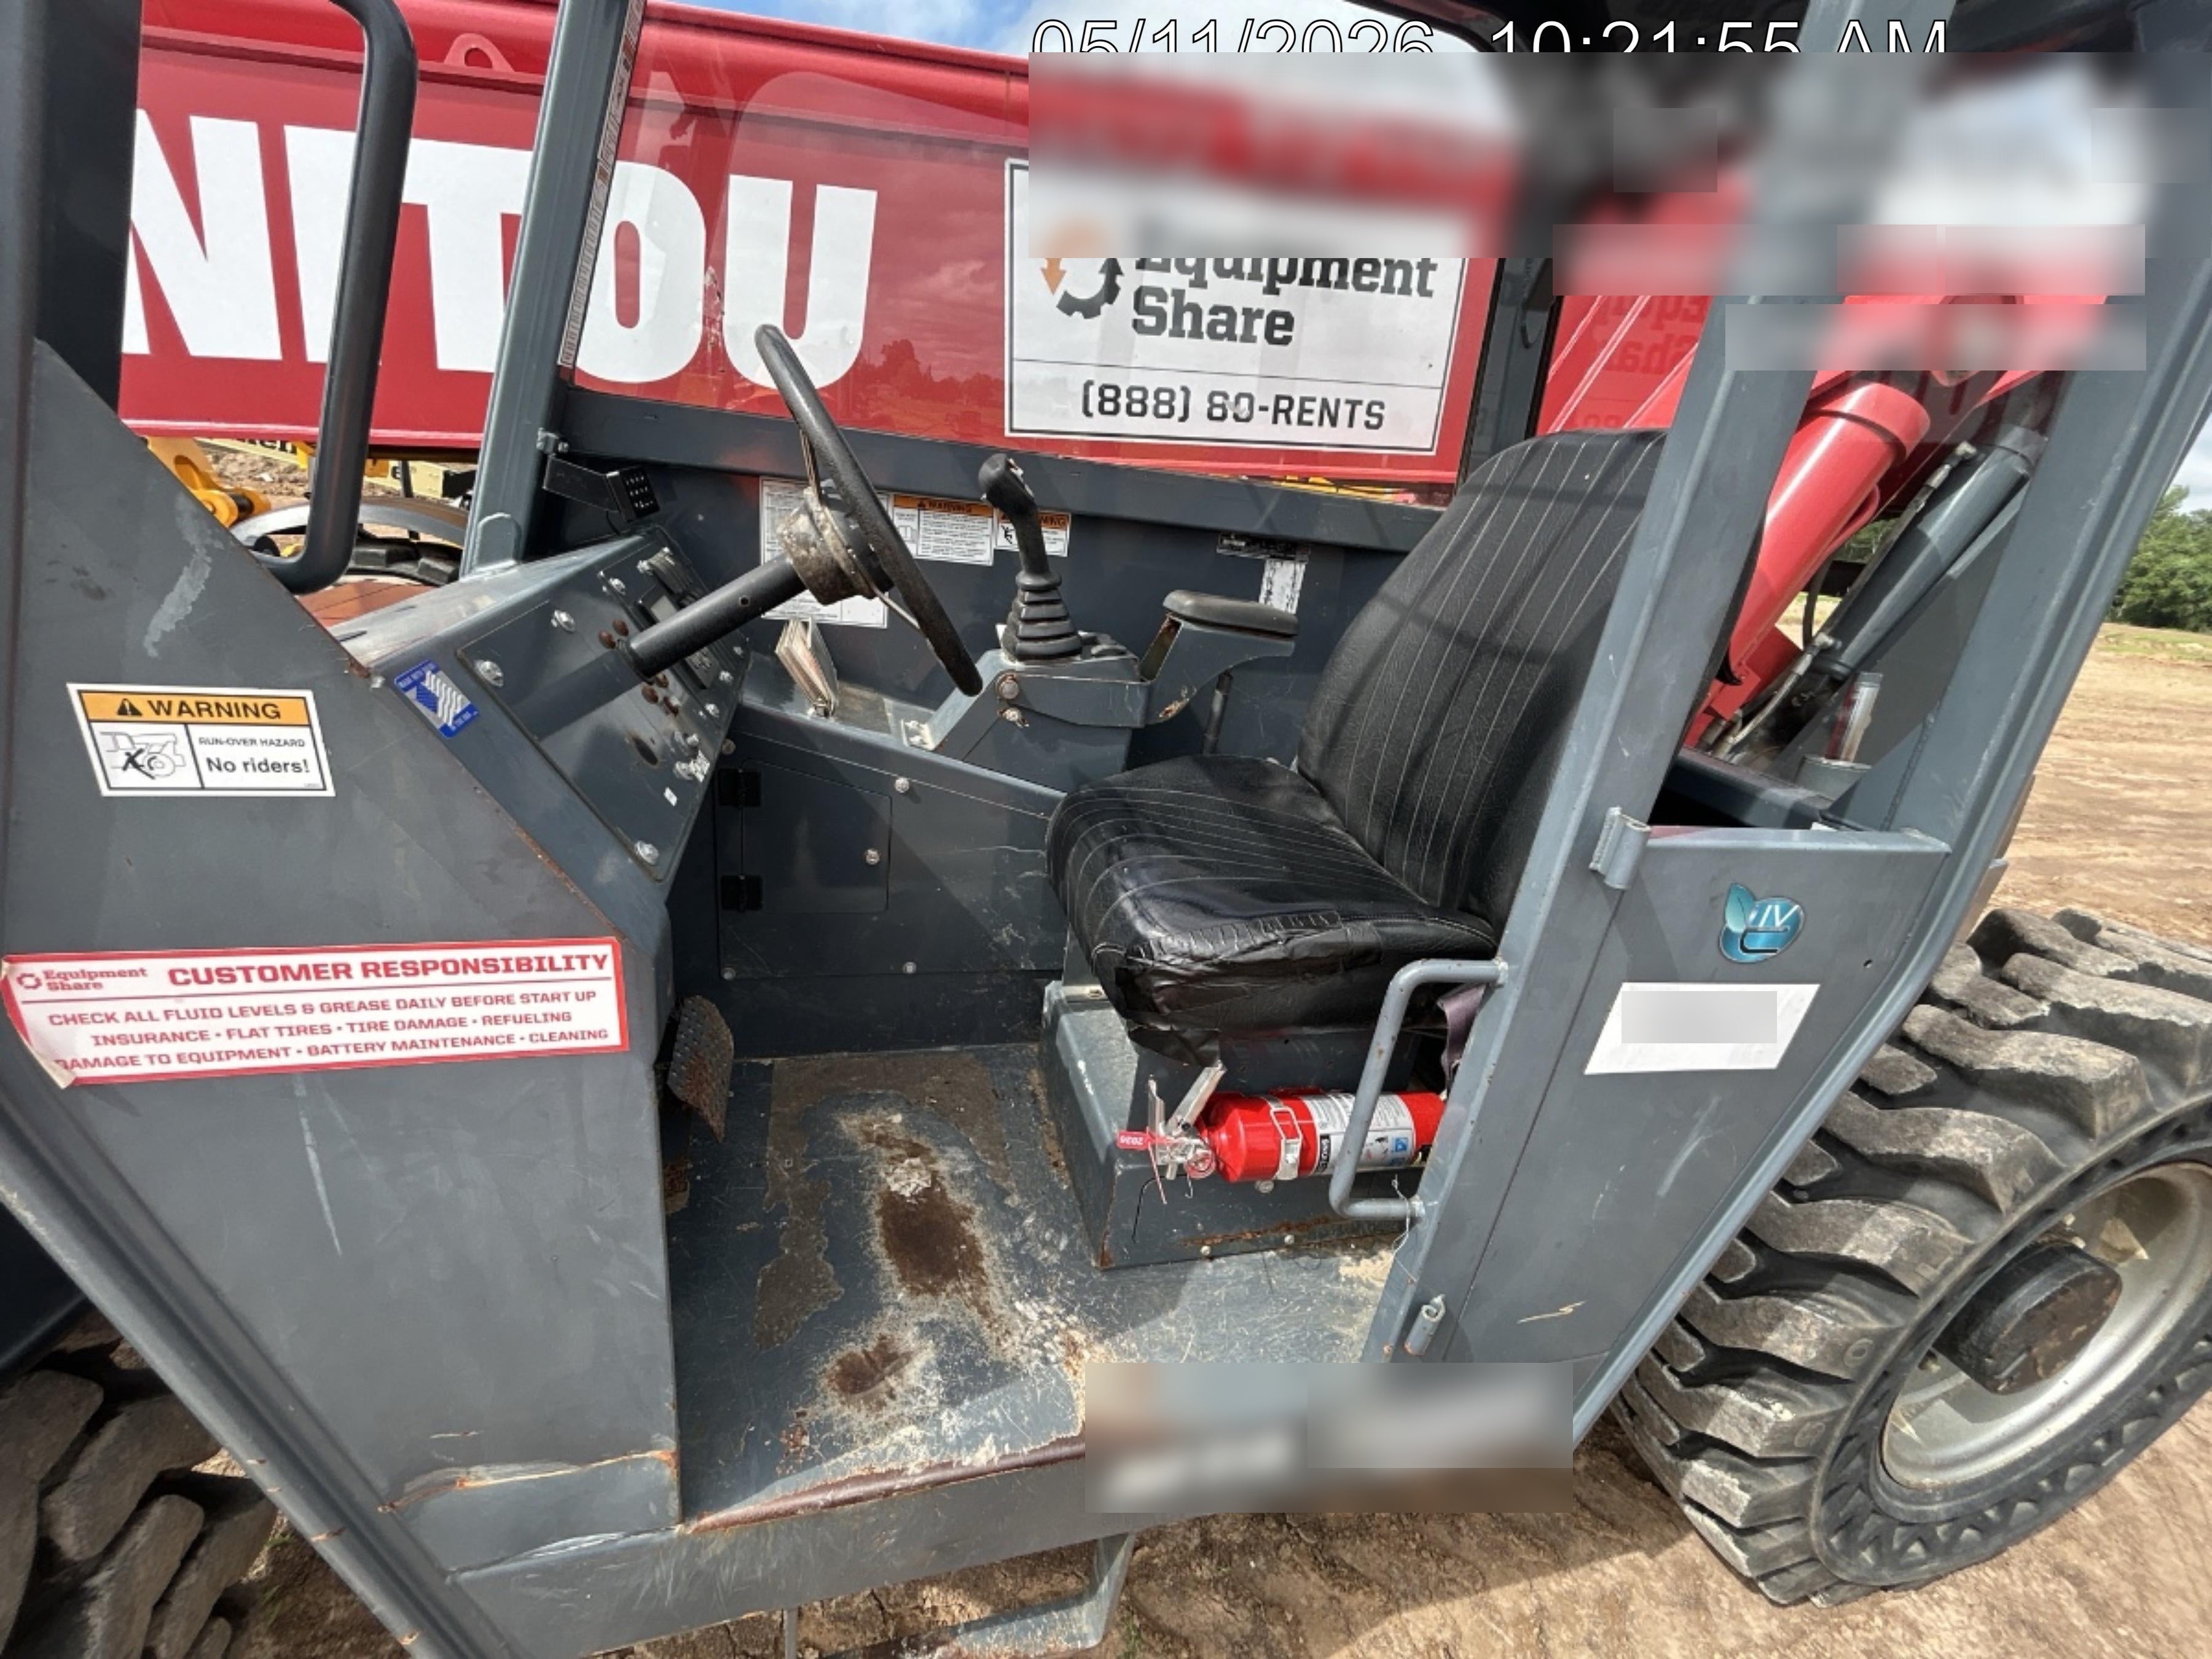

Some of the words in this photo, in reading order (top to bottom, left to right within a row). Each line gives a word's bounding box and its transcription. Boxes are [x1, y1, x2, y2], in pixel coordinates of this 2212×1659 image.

[1135, 258, 1438, 297] quipment
[1132, 284, 1295, 347] Share
[1082, 379, 1191, 423] (888)
[1206, 389, 1386, 429] 80-RENTS
[147, 699, 281, 720] WARNING
[198, 737, 257, 747] RUN-OVER
[259, 738, 305, 747] HAZARD
[206, 756, 237, 772] No
[242, 756, 310, 773] riders!
[44, 967, 148, 982] Equipment
[47, 981, 104, 991] Share
[168, 962, 353, 987] CUSTOMER
[361, 954, 608, 979] RESPONSIBILITY
[49, 1011, 120, 1026] CHECK
[124, 1010, 159, 1023] ALL
[163, 1007, 224, 1021] FLUID
[227, 1003, 297, 1019] LEVELS
[319, 1000, 391, 1014] GREASE
[396, 997, 447, 1011] DAILY
[452, 994, 516, 1008] BEFORE
[519, 992, 571, 1005] START
[575, 990, 597, 1003] UP
[92, 1030, 210, 1046] INSURANCE
[226, 1027, 269, 1040] FLAT
[276, 1024, 332, 1037] TIRES
[345, 1021, 390, 1034] TIRE
[394, 1017, 468, 1032] DAMAGE
[482, 1011, 572, 1027] REFUELING
[147, 1053, 171, 1065] TO
[176, 1046, 291, 1064] EQUIPMENT
[307, 1041, 386, 1057] BATTERY
[392, 1034, 516, 1051] MAINTENANCE
[529, 1029, 609, 1045] CLEANING
